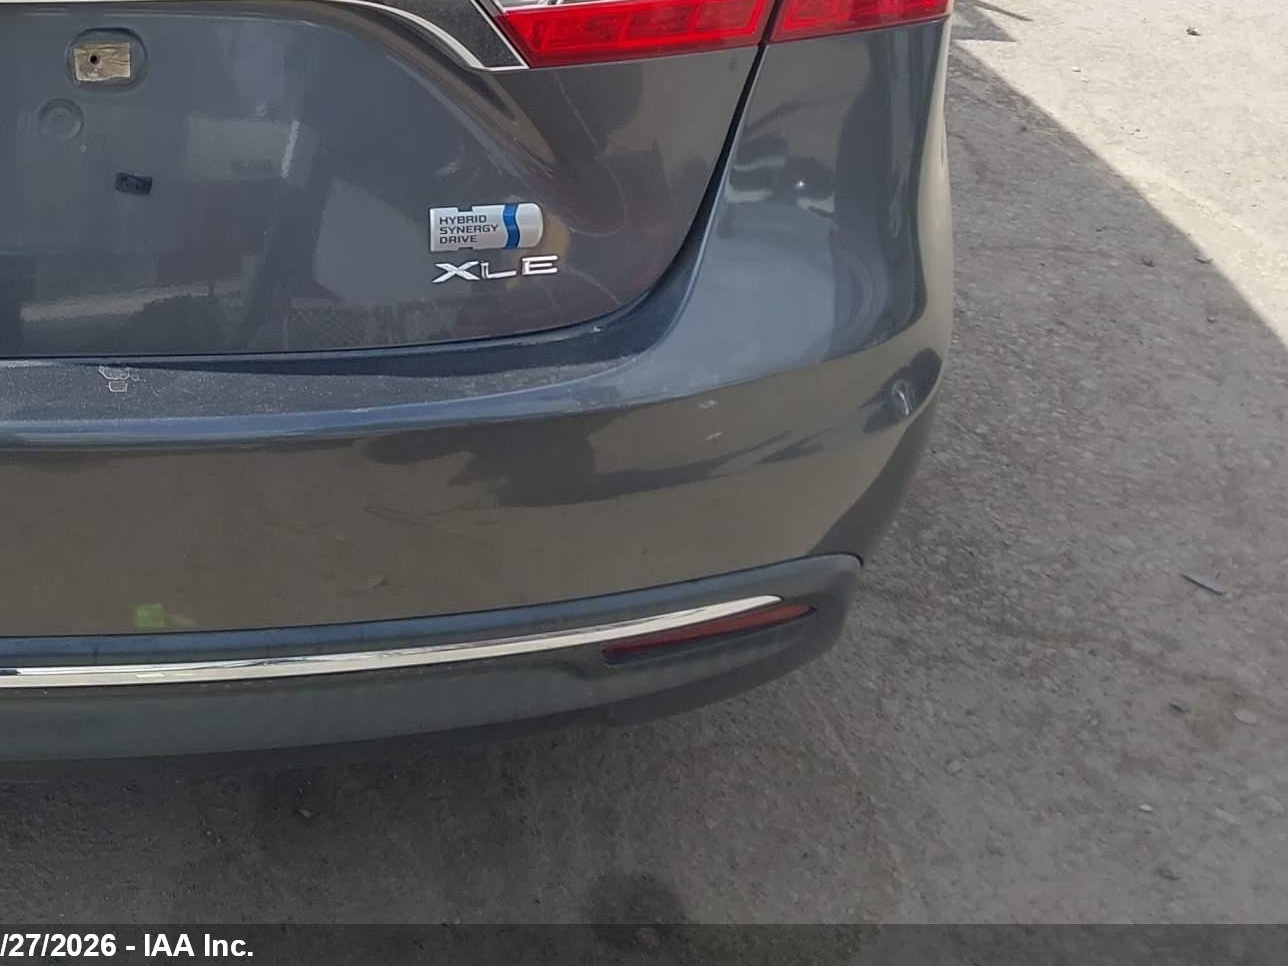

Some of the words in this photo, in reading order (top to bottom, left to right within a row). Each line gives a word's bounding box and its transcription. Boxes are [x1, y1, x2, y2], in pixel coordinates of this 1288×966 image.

[439, 214, 487, 225] HYBRID
[439, 224, 499, 235] SYNERGY
[439, 234, 478, 244] DRIVE
[432, 255, 559, 283] XLE
